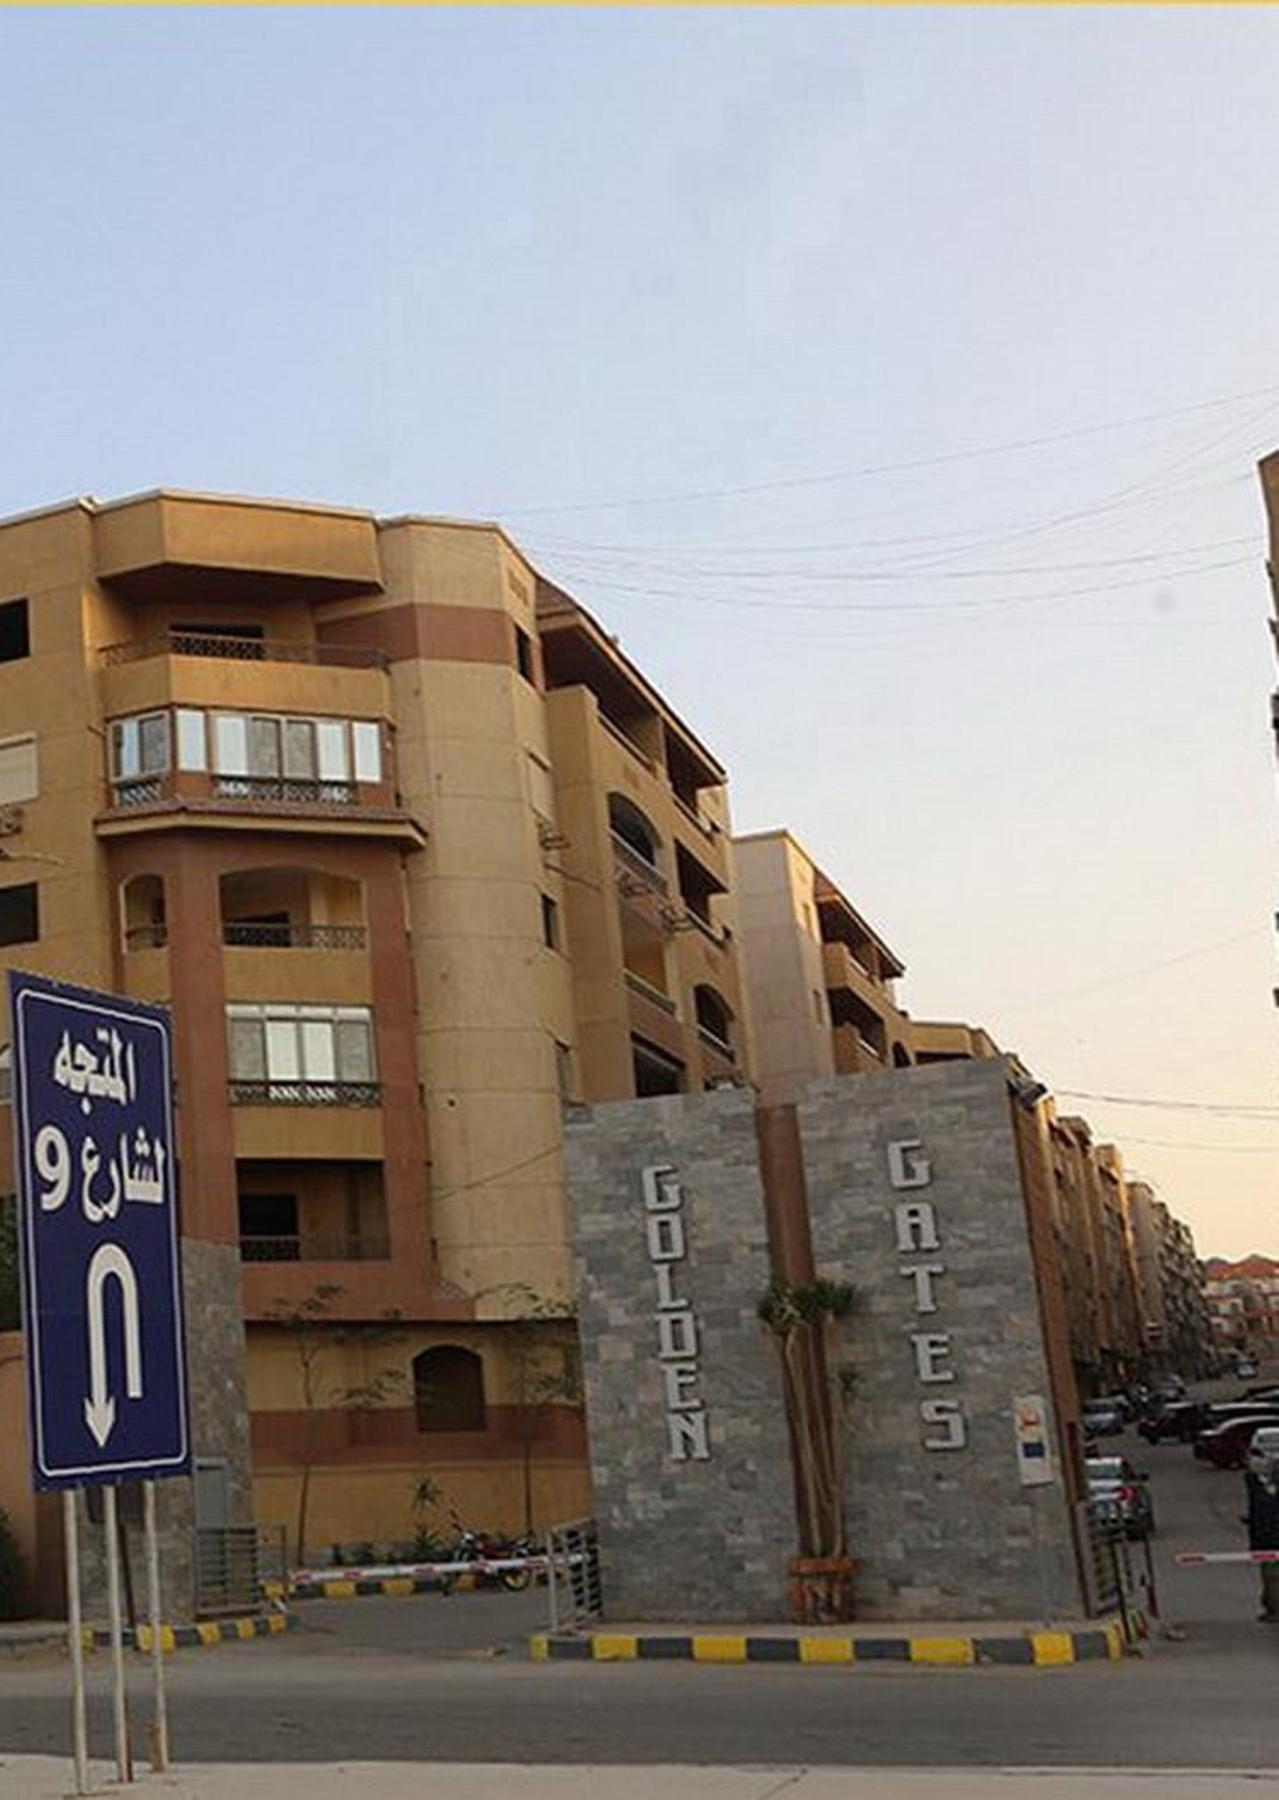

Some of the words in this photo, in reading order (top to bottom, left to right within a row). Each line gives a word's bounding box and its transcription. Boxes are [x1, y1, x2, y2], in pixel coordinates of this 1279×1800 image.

[53, 1027, 136, 1116] المتجه
[34, 1124, 70, 1211] 9
[81, 1126, 165, 1223] لشارع
[641, 1164, 710, 1461] GOLDEN
[886, 1140, 967, 1450] GATES
